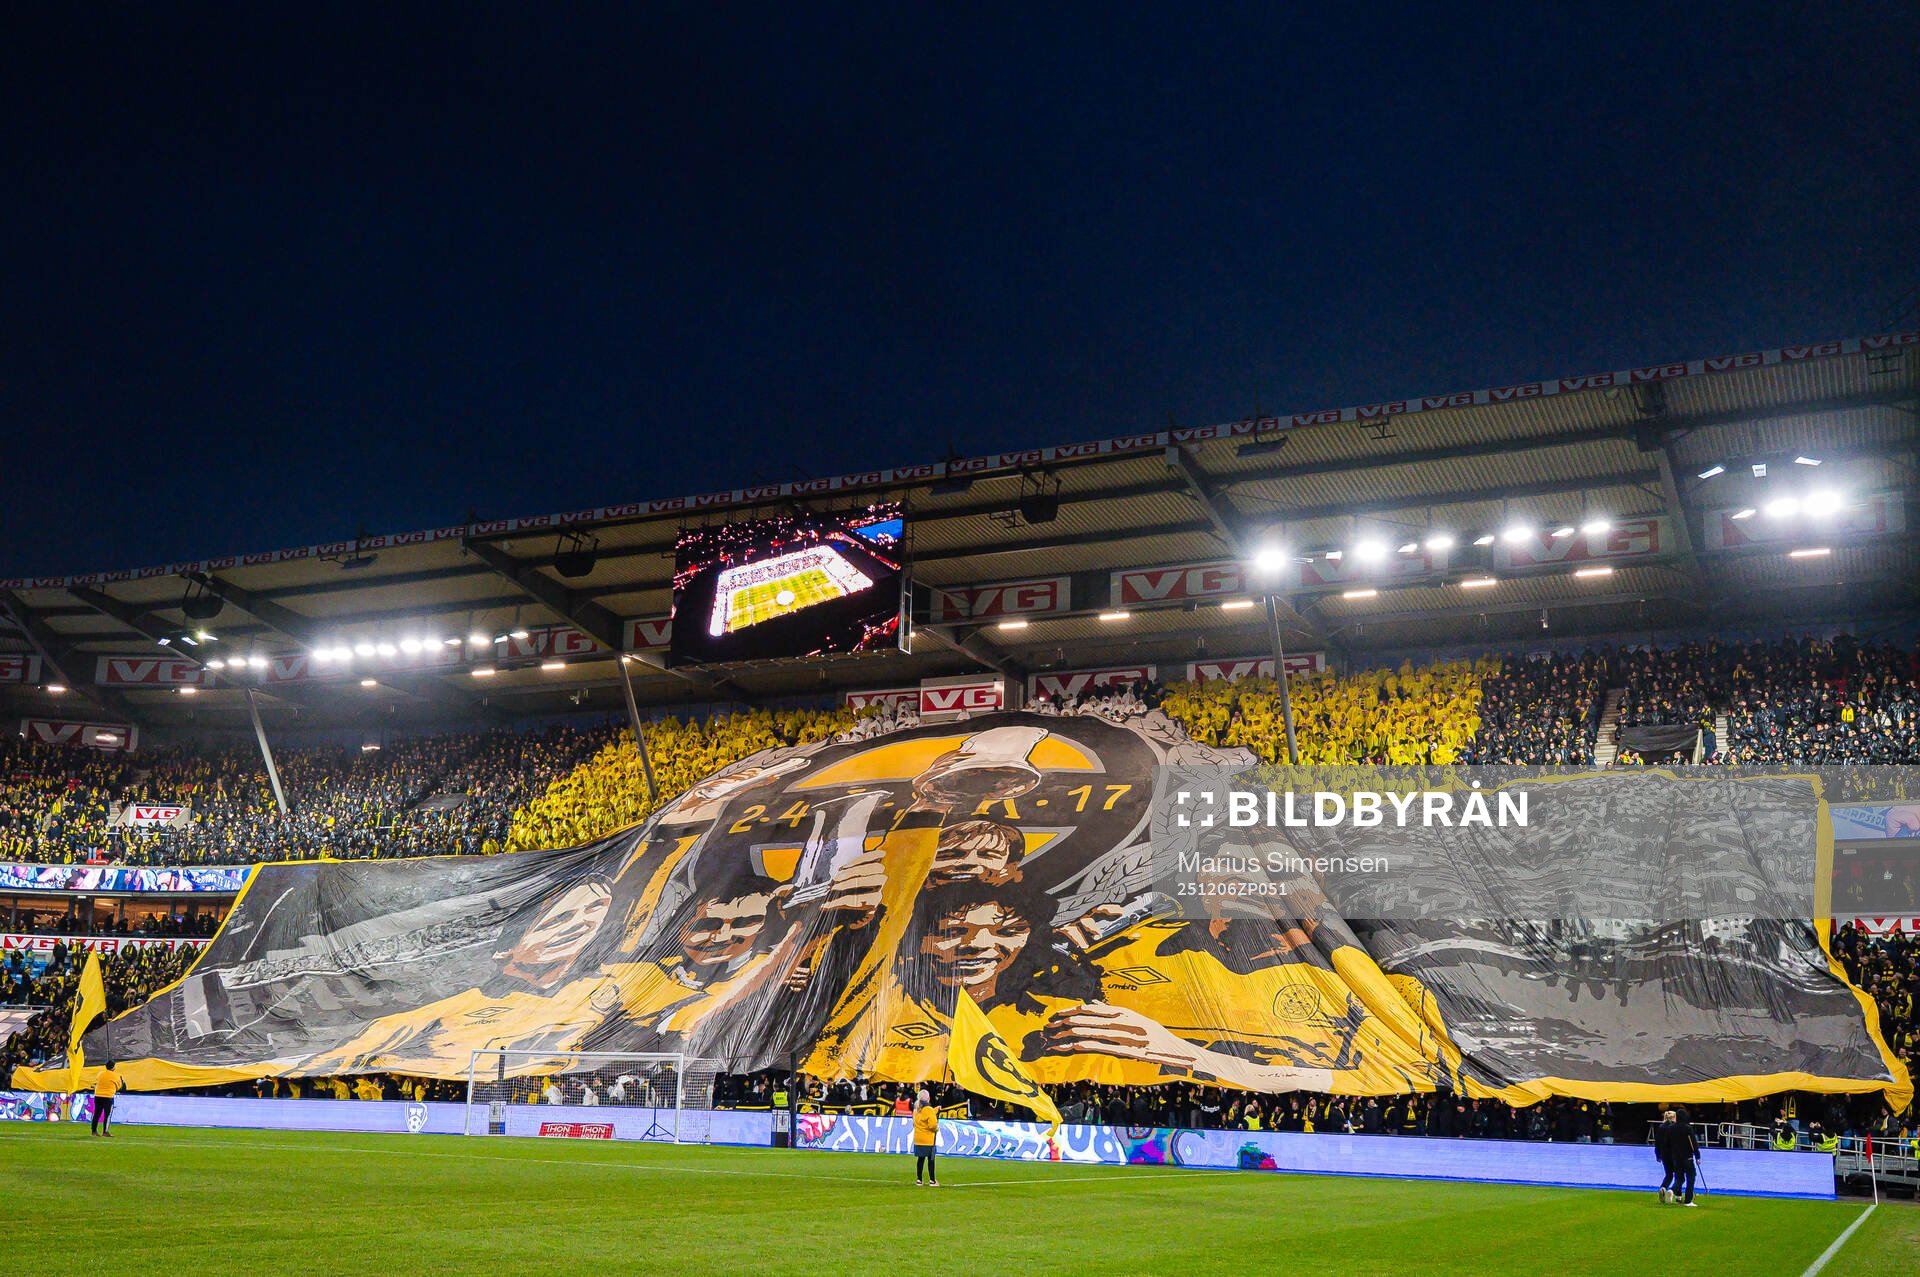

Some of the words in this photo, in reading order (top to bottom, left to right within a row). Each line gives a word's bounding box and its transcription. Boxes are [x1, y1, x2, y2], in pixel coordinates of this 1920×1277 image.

[436, 528, 465, 539] VG
[480, 521, 508, 533] VG
[520, 517, 549, 529] VG
[561, 511, 591, 523] VG
[605, 506, 637, 518] VG
[651, 500, 684, 511] VG
[697, 494, 730, 505] VG
[744, 487, 778, 499] VG
[793, 480, 827, 493] VG
[842, 473, 880, 486] VG
[895, 467, 931, 479] VG
[950, 461, 985, 473] VG
[1001, 452, 1040, 465] VG
[1057, 445, 1097, 458] VG
[1113, 436, 1154, 450] VG
[1172, 428, 1215, 442] VG
[1233, 419, 1276, 434] VG
[1294, 412, 1338, 426] VG
[1359, 403, 1405, 418] VG
[1423, 393, 1472, 410] VG
[1491, 385, 1540, 401] VG
[1561, 377, 1611, 391] VG
[1633, 366, 1686, 381] VG
[1706, 355, 1761, 371] VG
[1784, 344, 1838, 359] VG
[1864, 334, 1919, 349] VG
[1125, 569, 1239, 599] VG
[947, 584, 1050, 617] VG
[512, 631, 598, 655] VG
[637, 621, 671, 645] V
[111, 661, 202, 681] VG
[926, 687, 998, 709] VG
[32, 723, 125, 747] VG
[139, 808, 178, 819] VG
[7, 937, 57, 950] VG
[544, 1124, 573, 1133] THON
[580, 1124, 609, 1133] THON
